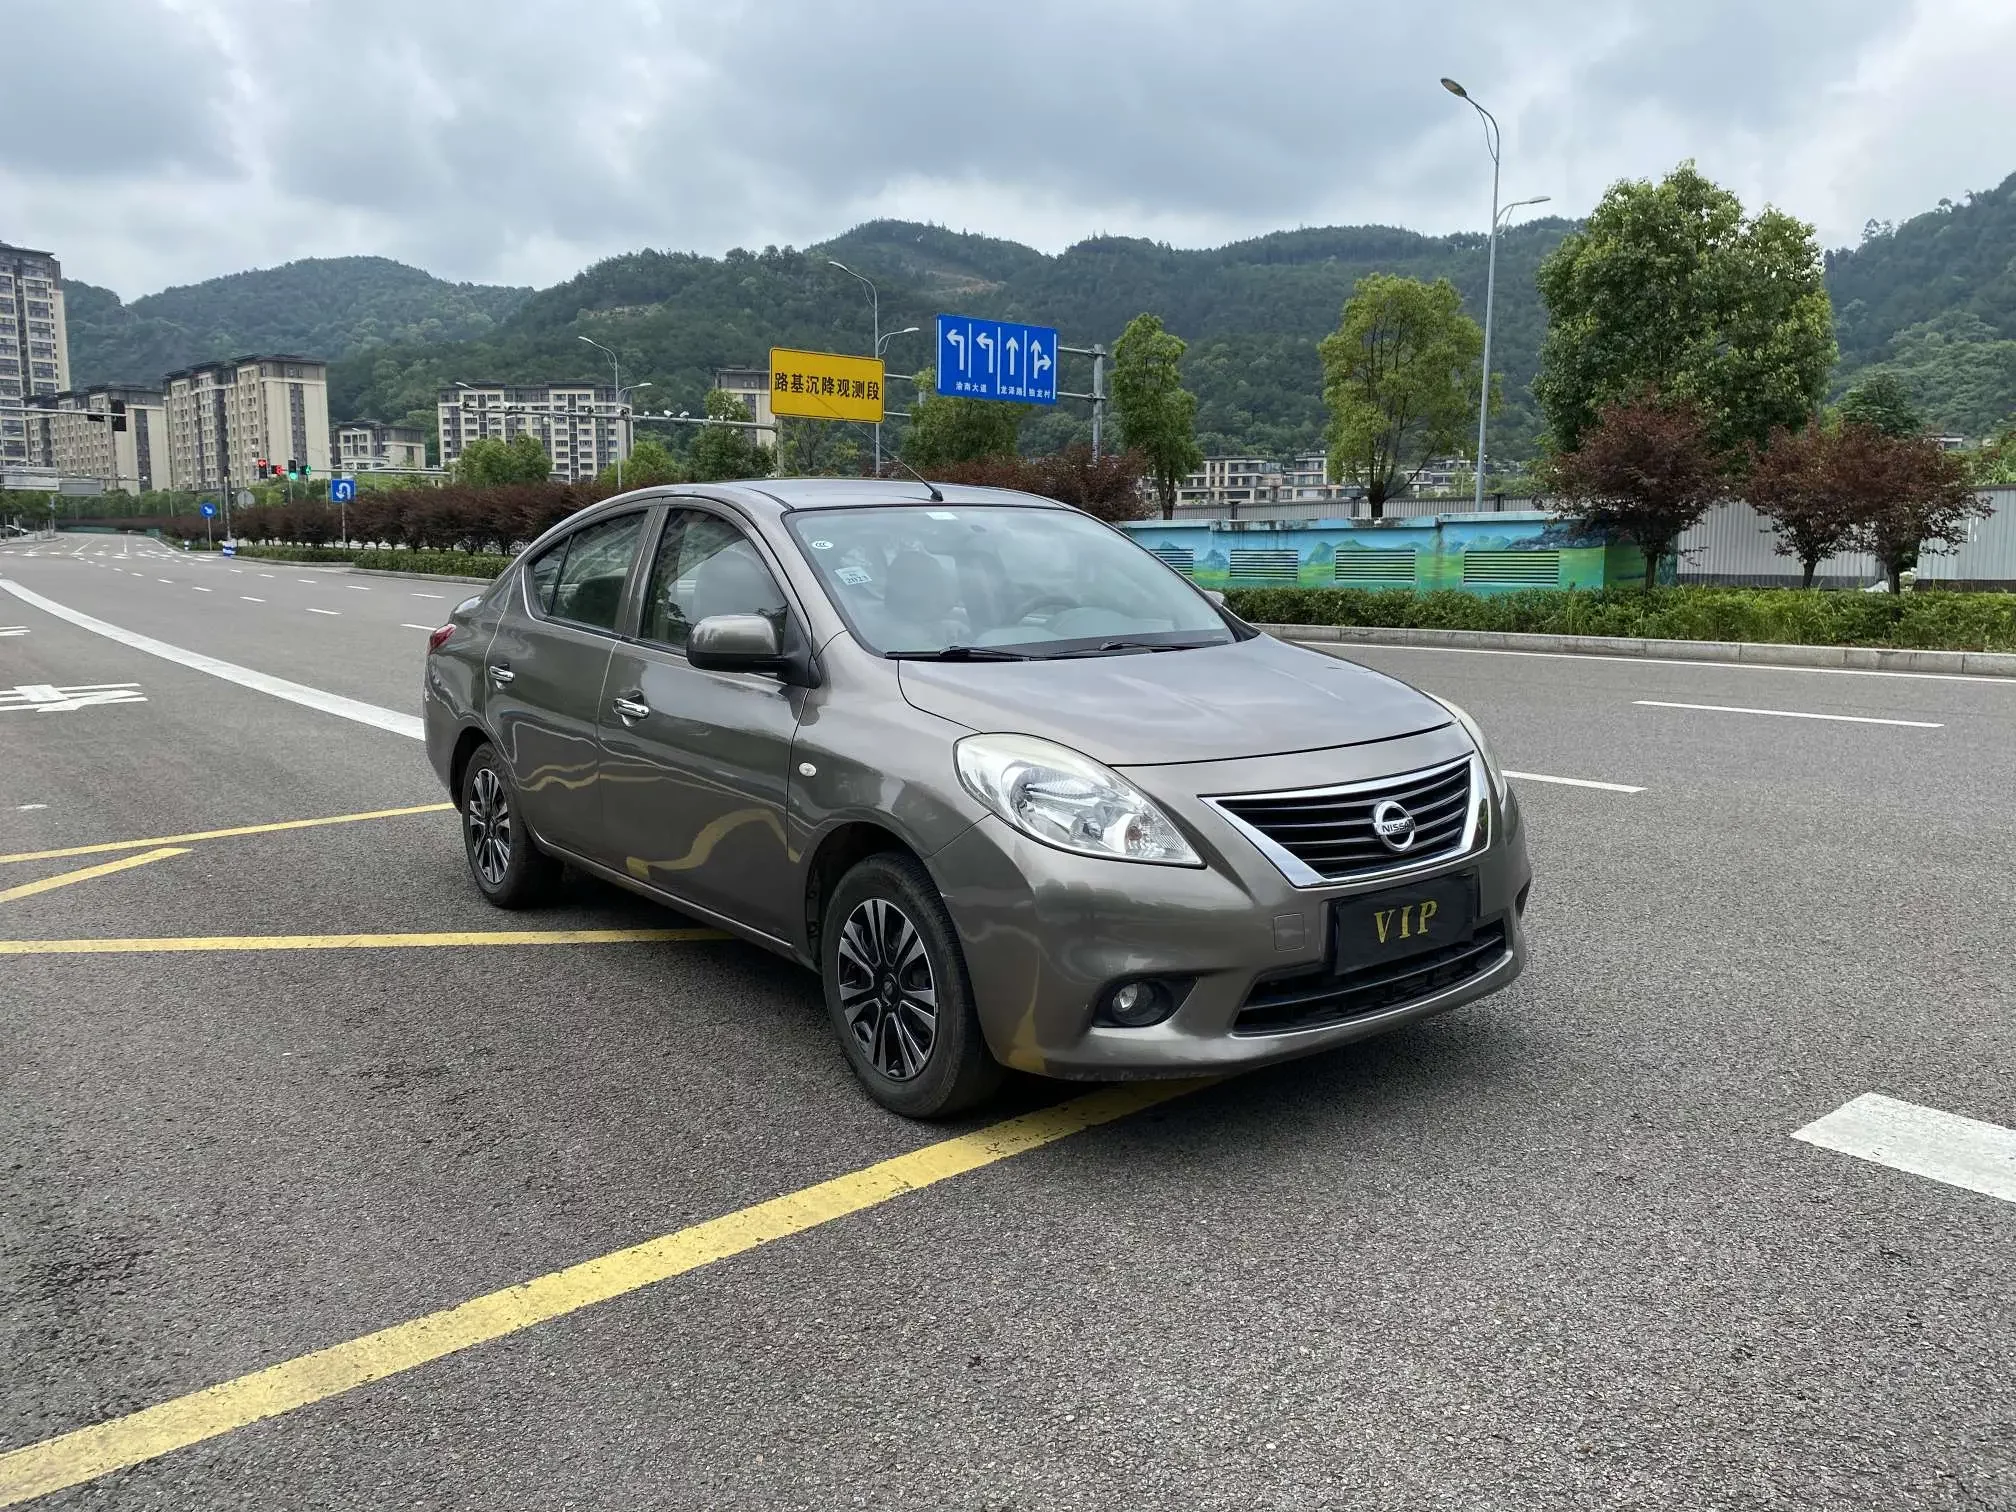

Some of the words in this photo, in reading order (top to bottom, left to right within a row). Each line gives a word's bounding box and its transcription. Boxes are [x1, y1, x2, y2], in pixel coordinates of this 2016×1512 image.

[775, 372, 879, 400] 路基沉降观测段
[956, 381, 987, 393] 渝南大道
[1381, 819, 1413, 833] NISSA
[1374, 900, 1437, 943] VIP
